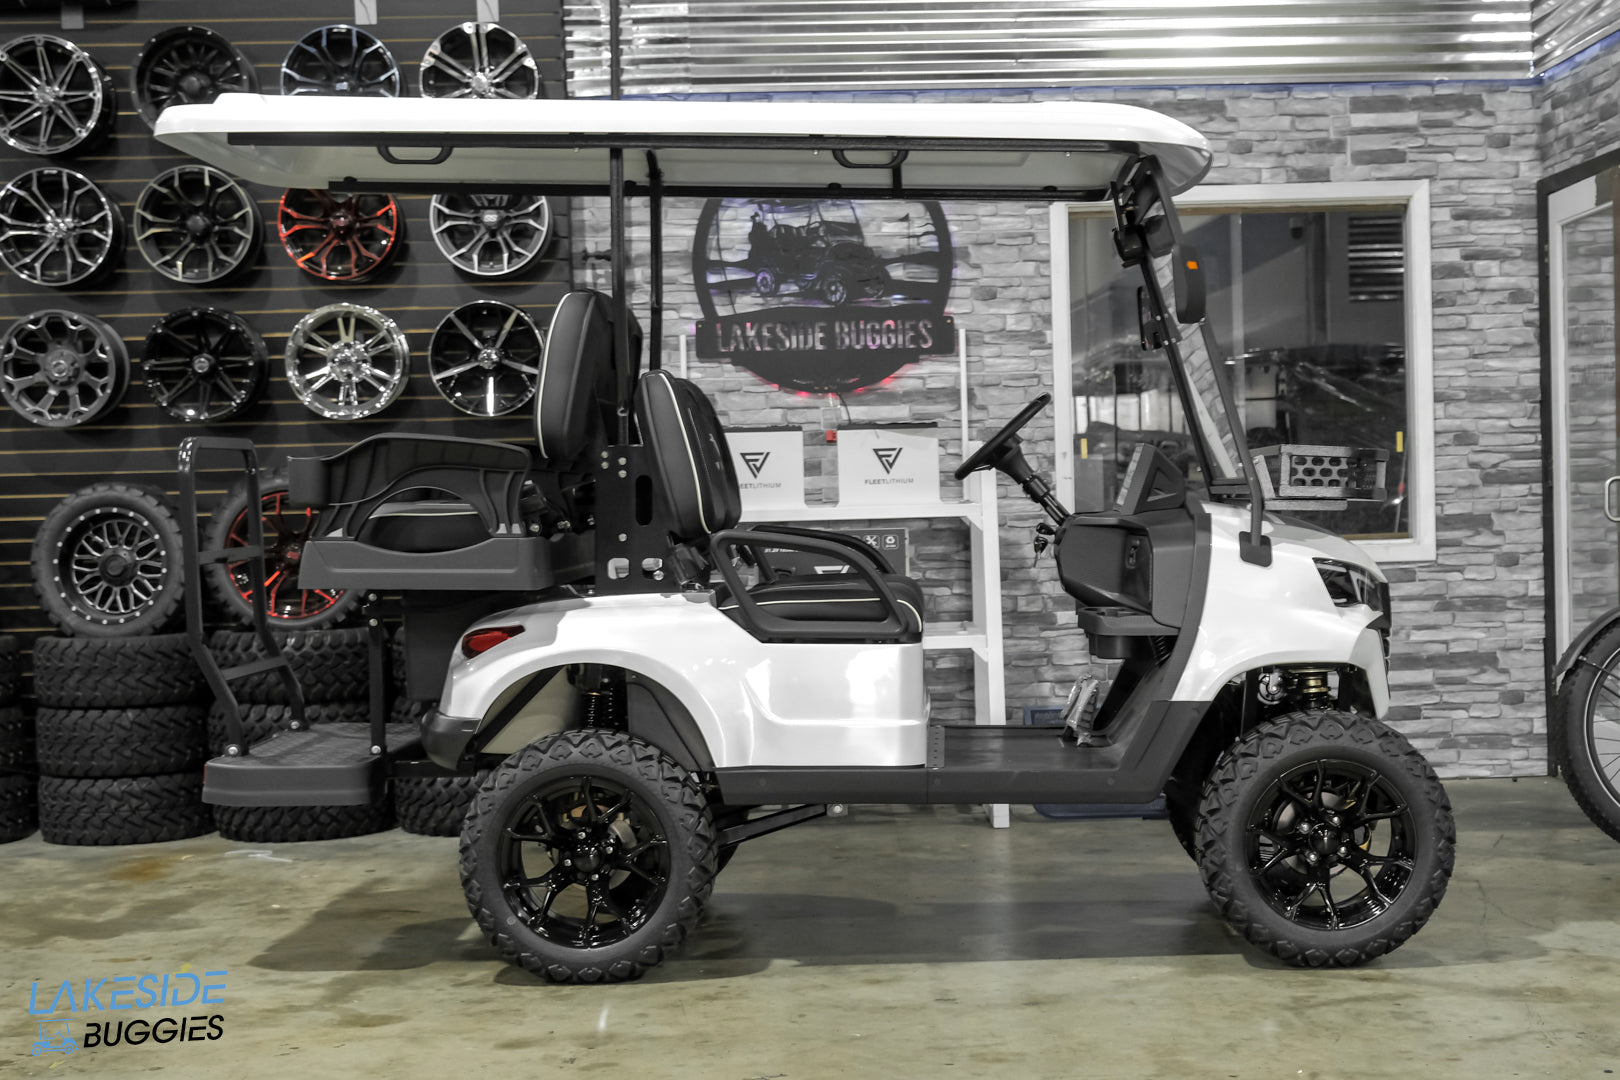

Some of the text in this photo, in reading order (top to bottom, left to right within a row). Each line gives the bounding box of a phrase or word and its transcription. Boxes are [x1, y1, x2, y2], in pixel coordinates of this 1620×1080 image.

[716, 318, 933, 352] LAKESIDE BUGGIES
[864, 477, 914, 485] FLEETLITHIUM
[740, 482, 782, 490] EETLITHIUM
